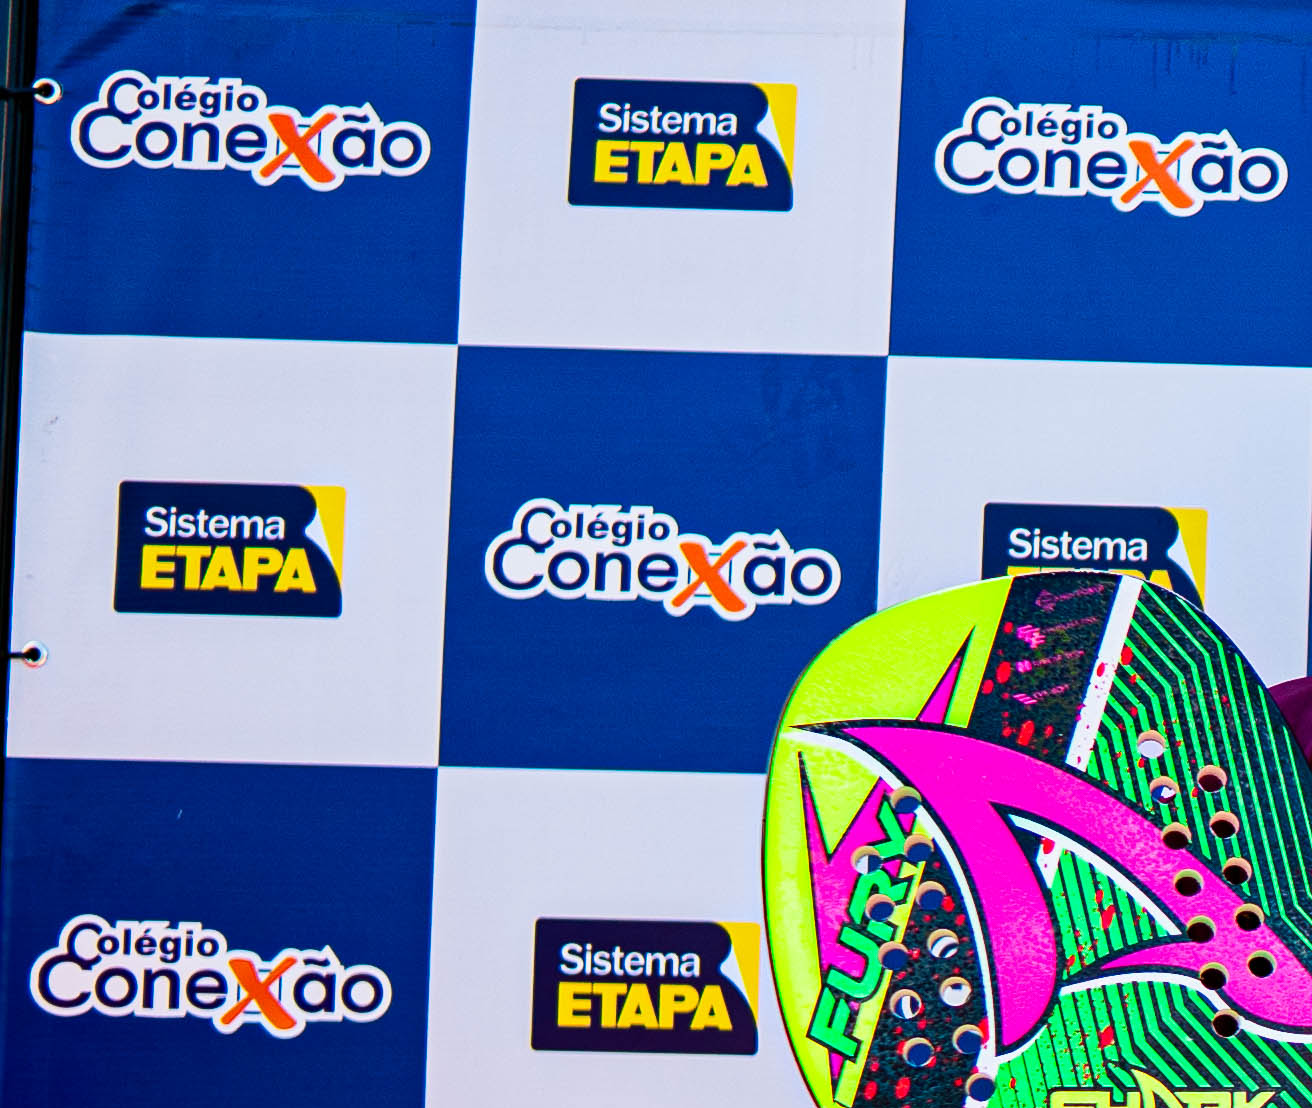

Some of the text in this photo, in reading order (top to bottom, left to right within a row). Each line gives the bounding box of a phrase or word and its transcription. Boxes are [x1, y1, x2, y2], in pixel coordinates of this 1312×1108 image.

[106, 78, 259, 121] Colégio
[599, 104, 738, 135] Sistema
[970, 105, 1119, 148] Colégio
[594, 140, 767, 187] ETAPA
[144, 507, 285, 539] Sistema
[520, 508, 670, 550] Colégio
[1008, 528, 1148, 561] Sistema
[141, 545, 316, 592] ETAPA
[66, 923, 219, 966] Colégio
[807, 797, 910, 1060] FURY
[560, 944, 700, 977] Sistema
[557, 982, 732, 1030] ETAPA
